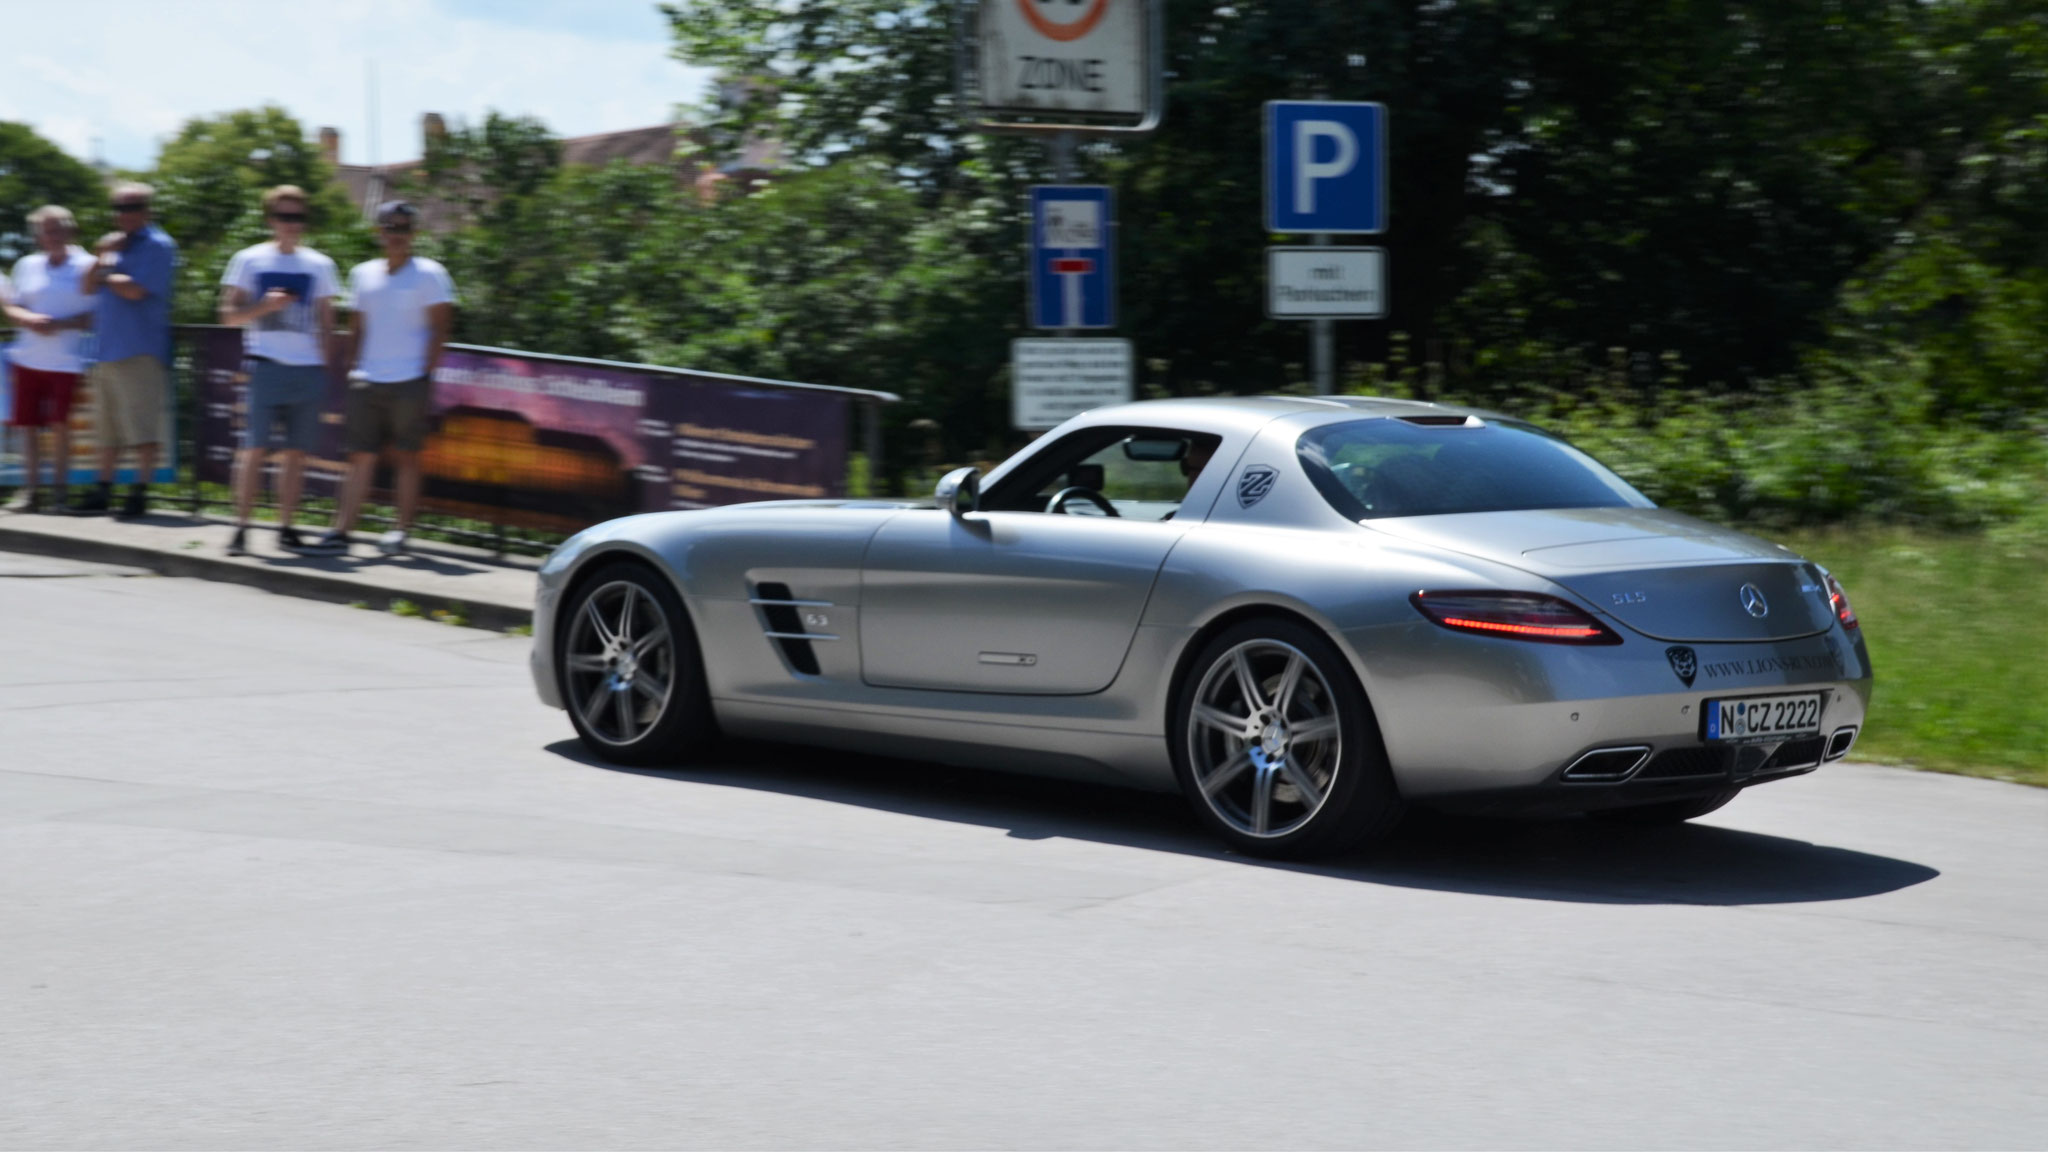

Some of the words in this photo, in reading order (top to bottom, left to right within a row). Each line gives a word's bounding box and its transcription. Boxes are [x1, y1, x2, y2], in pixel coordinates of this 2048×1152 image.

[1018, 56, 1106, 92] ZONE
[1293, 120, 1359, 214] P
[1612, 592, 1646, 605] SLS
[1721, 705, 1734, 734] N
[1748, 703, 1771, 732] CZ
[1775, 699, 1817, 730] 2222
